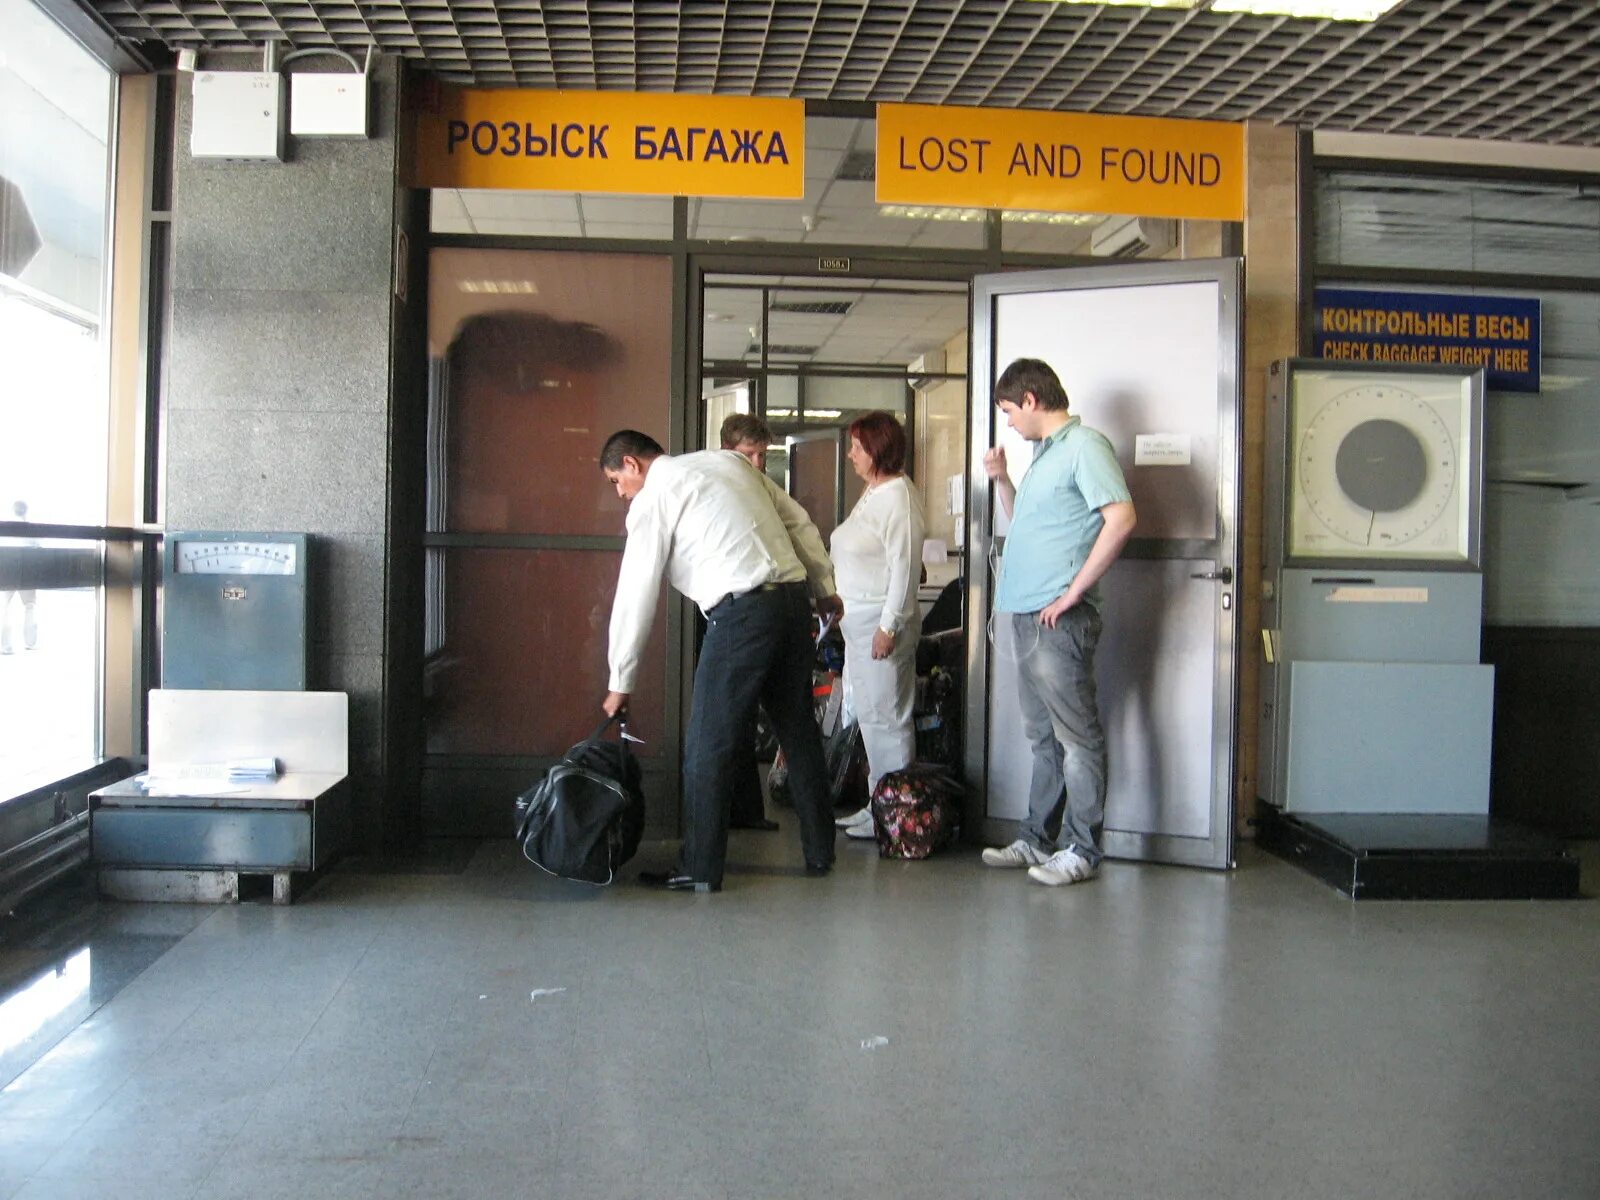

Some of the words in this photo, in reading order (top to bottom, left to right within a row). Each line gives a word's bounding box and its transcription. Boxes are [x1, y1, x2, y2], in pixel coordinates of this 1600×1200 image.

[448, 119, 609, 159] РОЗЫСК
[634, 125, 789, 165] БАГАЖА
[899, 135, 991, 173] LOST
[1008, 142, 1081, 178] AND
[1101, 148, 1221, 187] FOUND
[1322, 308, 1470, 338] КОНТРОЛЬНЫЕ
[1476, 315, 1529, 340] ВЕСЫ
[1323, 340, 1368, 361] CHECK
[1373, 343, 1436, 364] BAGGAGE
[1440, 346, 1491, 368] WEIGHT
[1495, 348, 1529, 372] HERE
